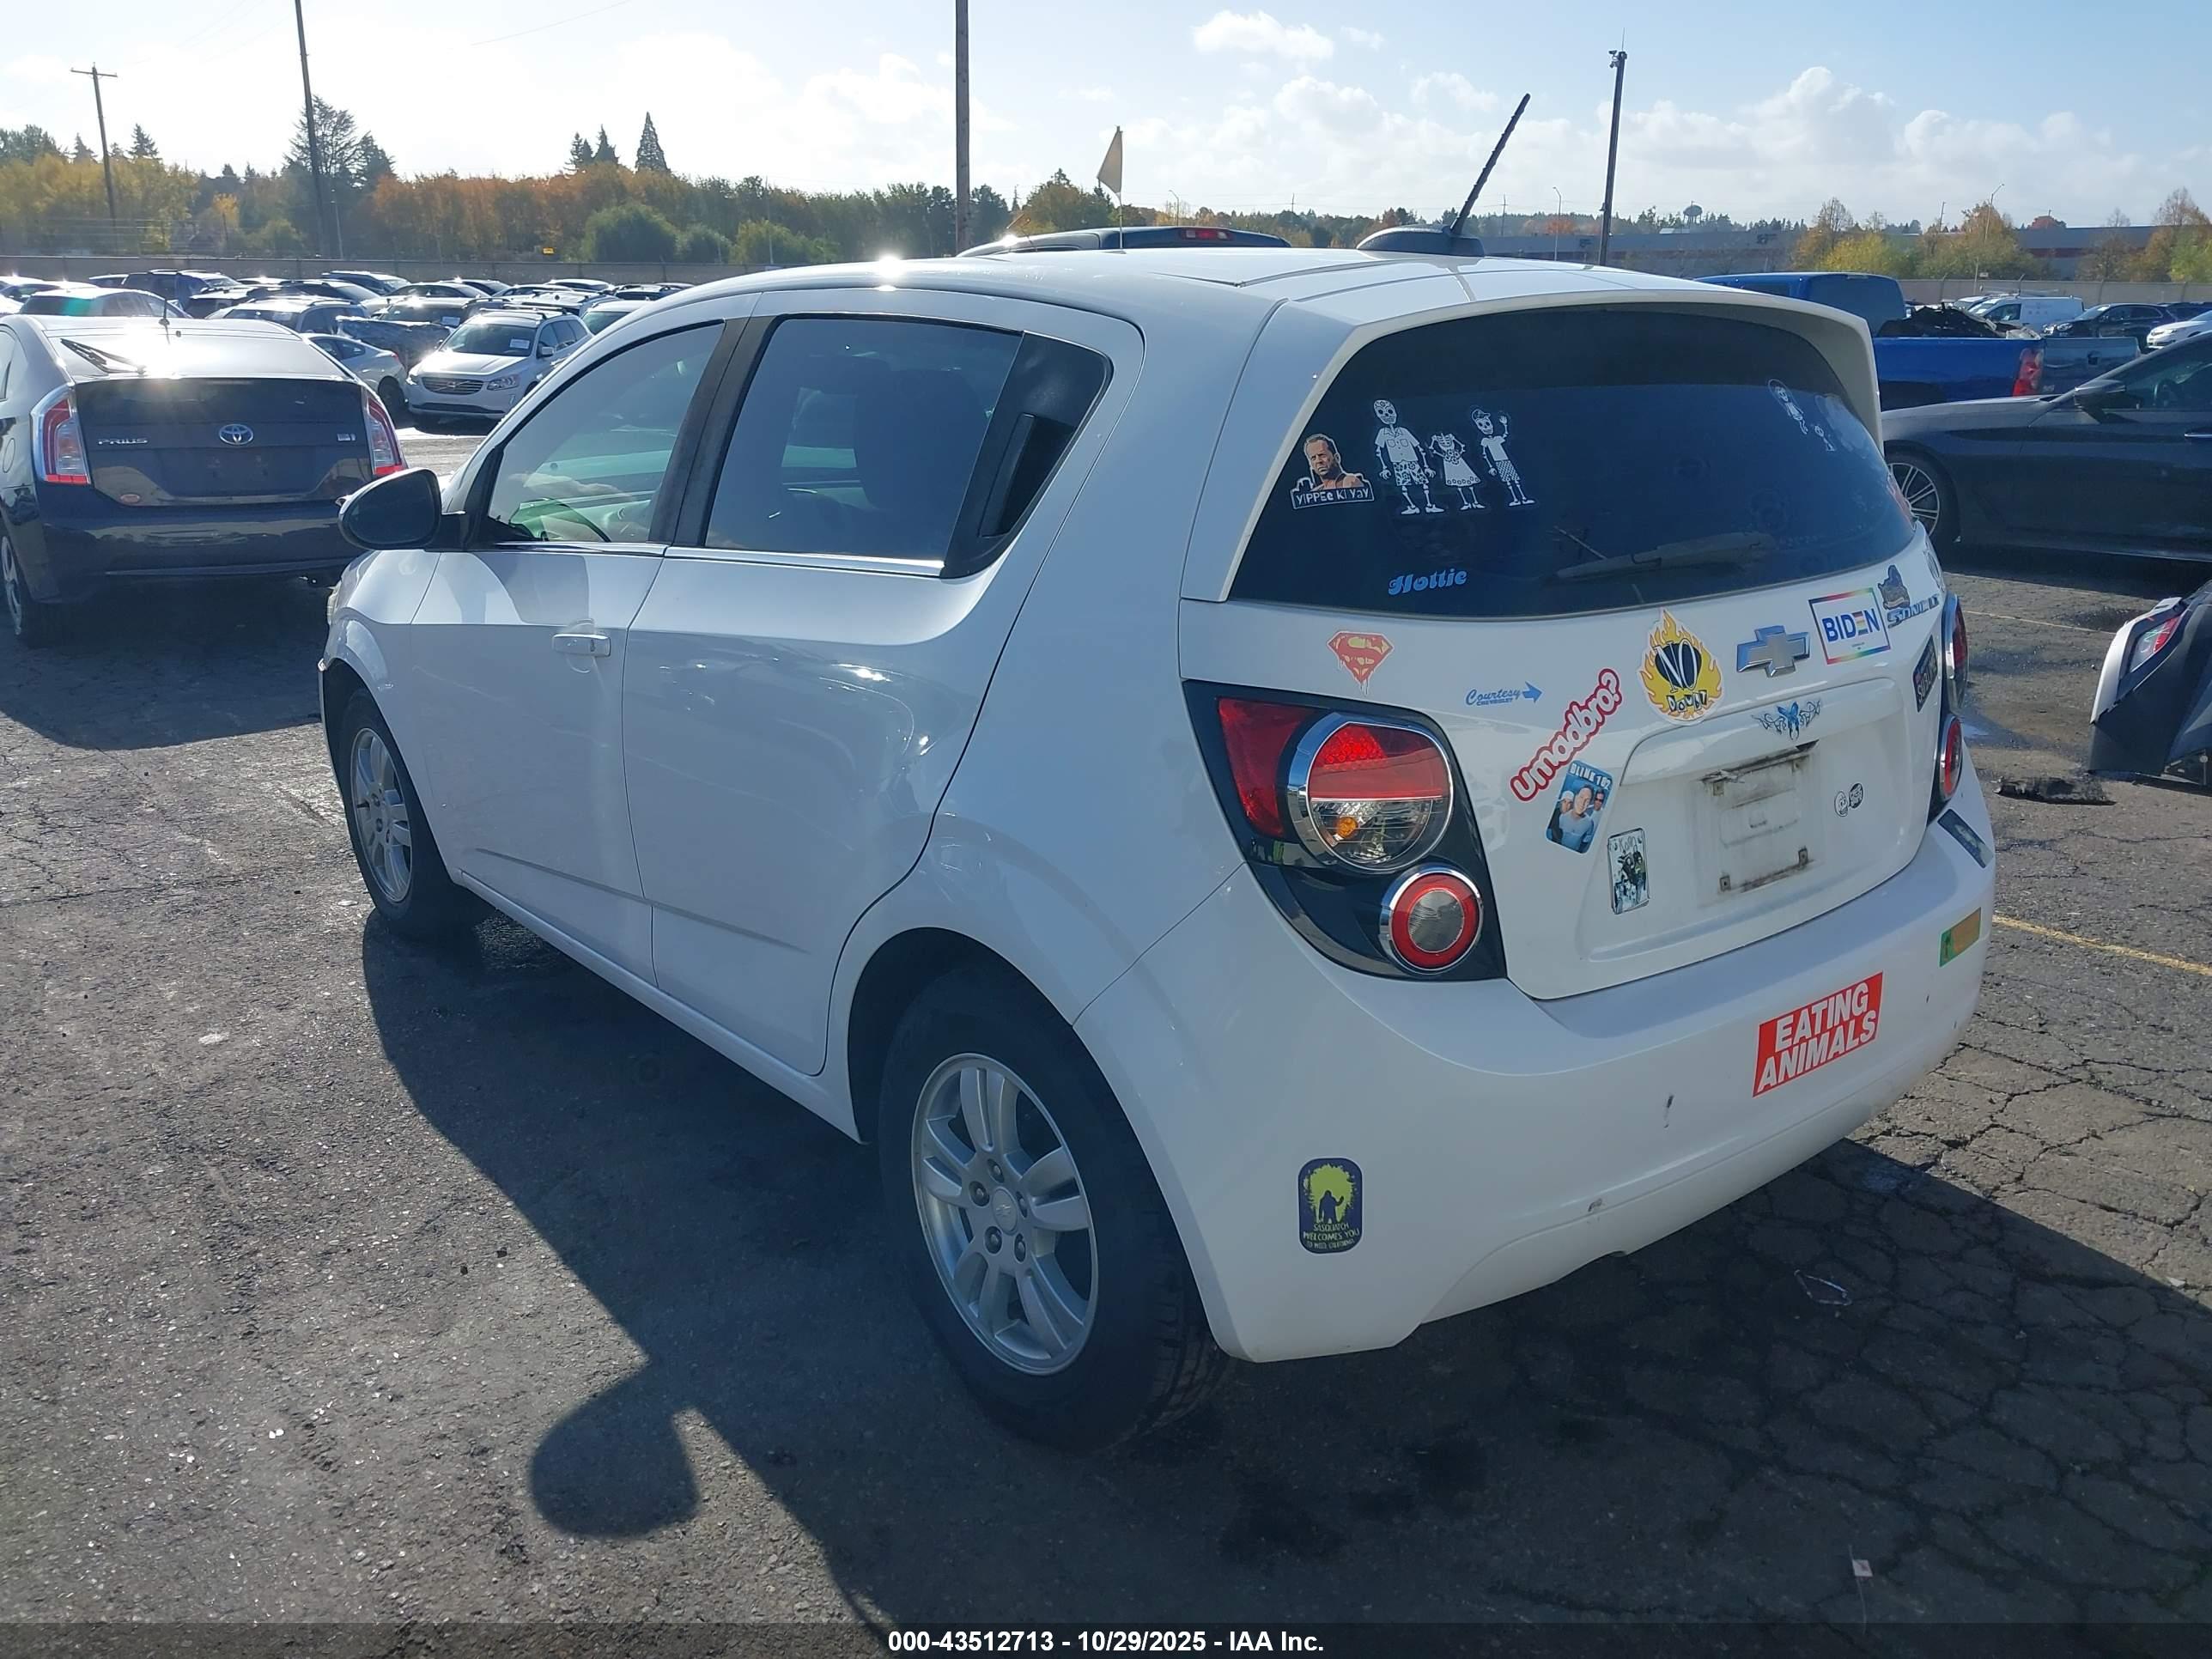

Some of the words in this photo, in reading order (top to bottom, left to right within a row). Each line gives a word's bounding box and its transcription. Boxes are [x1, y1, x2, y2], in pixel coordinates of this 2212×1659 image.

[1389, 568, 1467, 595] Hottie
[1822, 608, 1880, 642] BIDEN
[1654, 639, 1697, 694] NO
[1466, 689, 1521, 706] Courtesy
[1512, 669, 1621, 800] umadbro?
[1775, 982, 1869, 1053] EATING
[1757, 1010, 1876, 1093] ANIMALS
[1313, 1222, 1350, 1232] SASQUATCH
[1344, 1228, 1360, 1238] YOU
